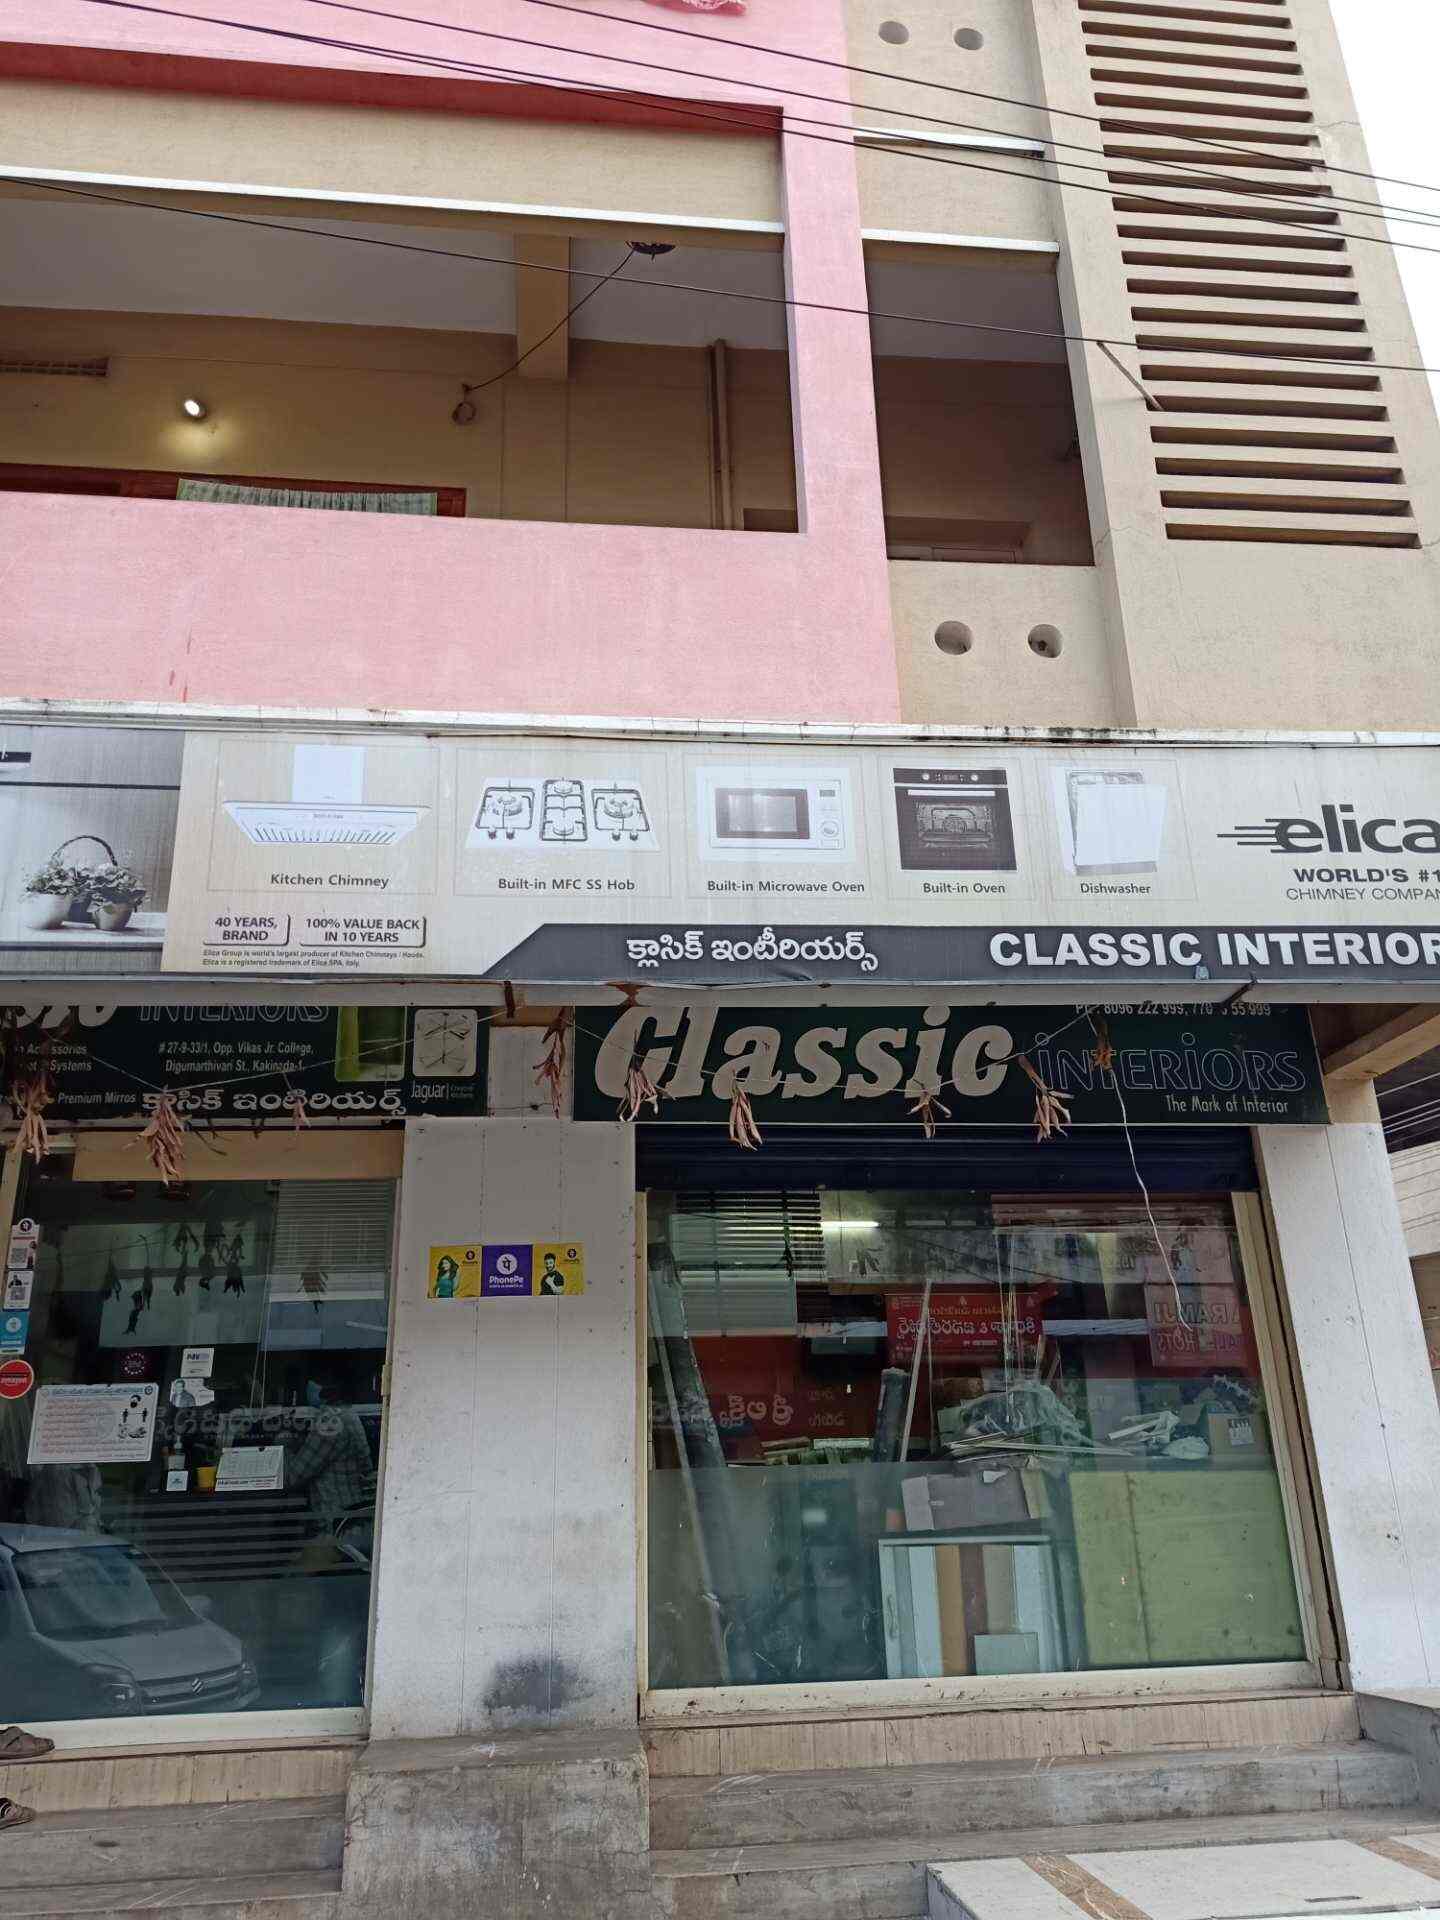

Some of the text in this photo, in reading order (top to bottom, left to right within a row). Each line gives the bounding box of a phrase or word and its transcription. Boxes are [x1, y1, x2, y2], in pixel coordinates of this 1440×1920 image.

[1265, 804, 1440, 853] elica
[271, 873, 390, 890] Kitchen Chimney
[1293, 868, 1440, 883] WORLD'S #1
[498, 878, 635, 891] Built-in MFC SS Hob
[707, 880, 865, 893] Built-in Microwave Oven
[922, 882, 1006, 895] Built-in Oven
[1080, 882, 1152, 895] Dishwasher
[1286, 887, 1366, 901] CHIMNEY
[214, 917, 278, 930] 40 YEARS,
[306, 918, 420, 930] 100% VALUE BACK
[222, 930, 269, 941] BRAND
[324, 932, 399, 943] IN 10 YEARS
[627, 931, 704, 968] క్లాసిక్
[989, 932, 1202, 967] CLASSIC
[213, 1042, 235, 1056] Opp.
[238, 1041, 262, 1054] Vikas
[278, 1041, 314, 1056] College,
[595, 1005, 1014, 1099] Classic
[49, 1059, 93, 1074] Systems
[57, 1091, 103, 1105] Premium
[410, 1079, 447, 1104] Jaguar
[1166, 1093, 1289, 1113] The Mark of Interior
[488, 1274, 525, 1285] PhonePe
